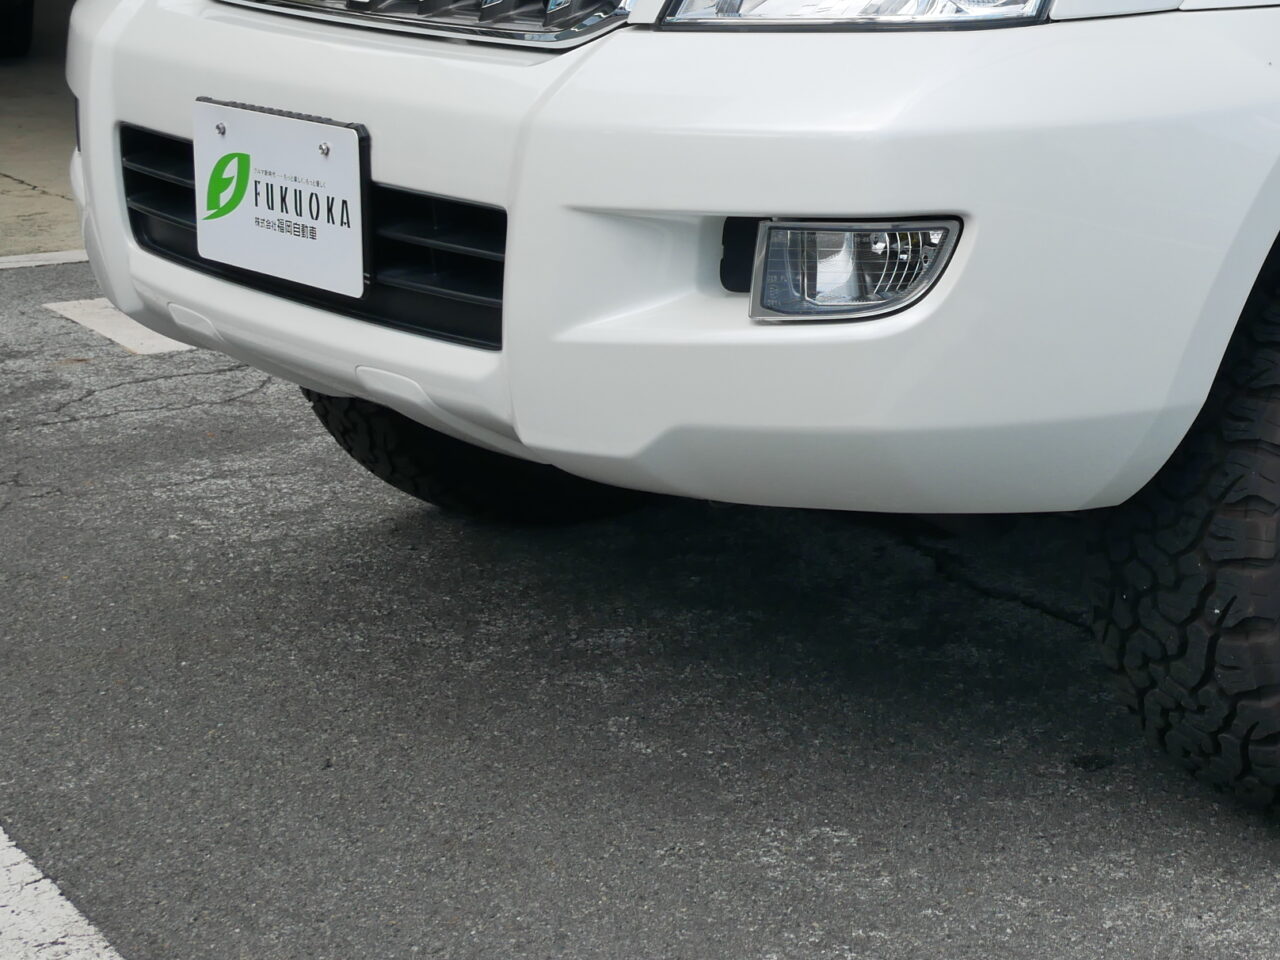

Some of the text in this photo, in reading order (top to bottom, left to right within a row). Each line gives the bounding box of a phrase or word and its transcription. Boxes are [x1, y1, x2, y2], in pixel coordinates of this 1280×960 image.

[254, 180, 351, 228] FUKUOKA
[255, 216, 317, 241] 株式会社福岡自動車
